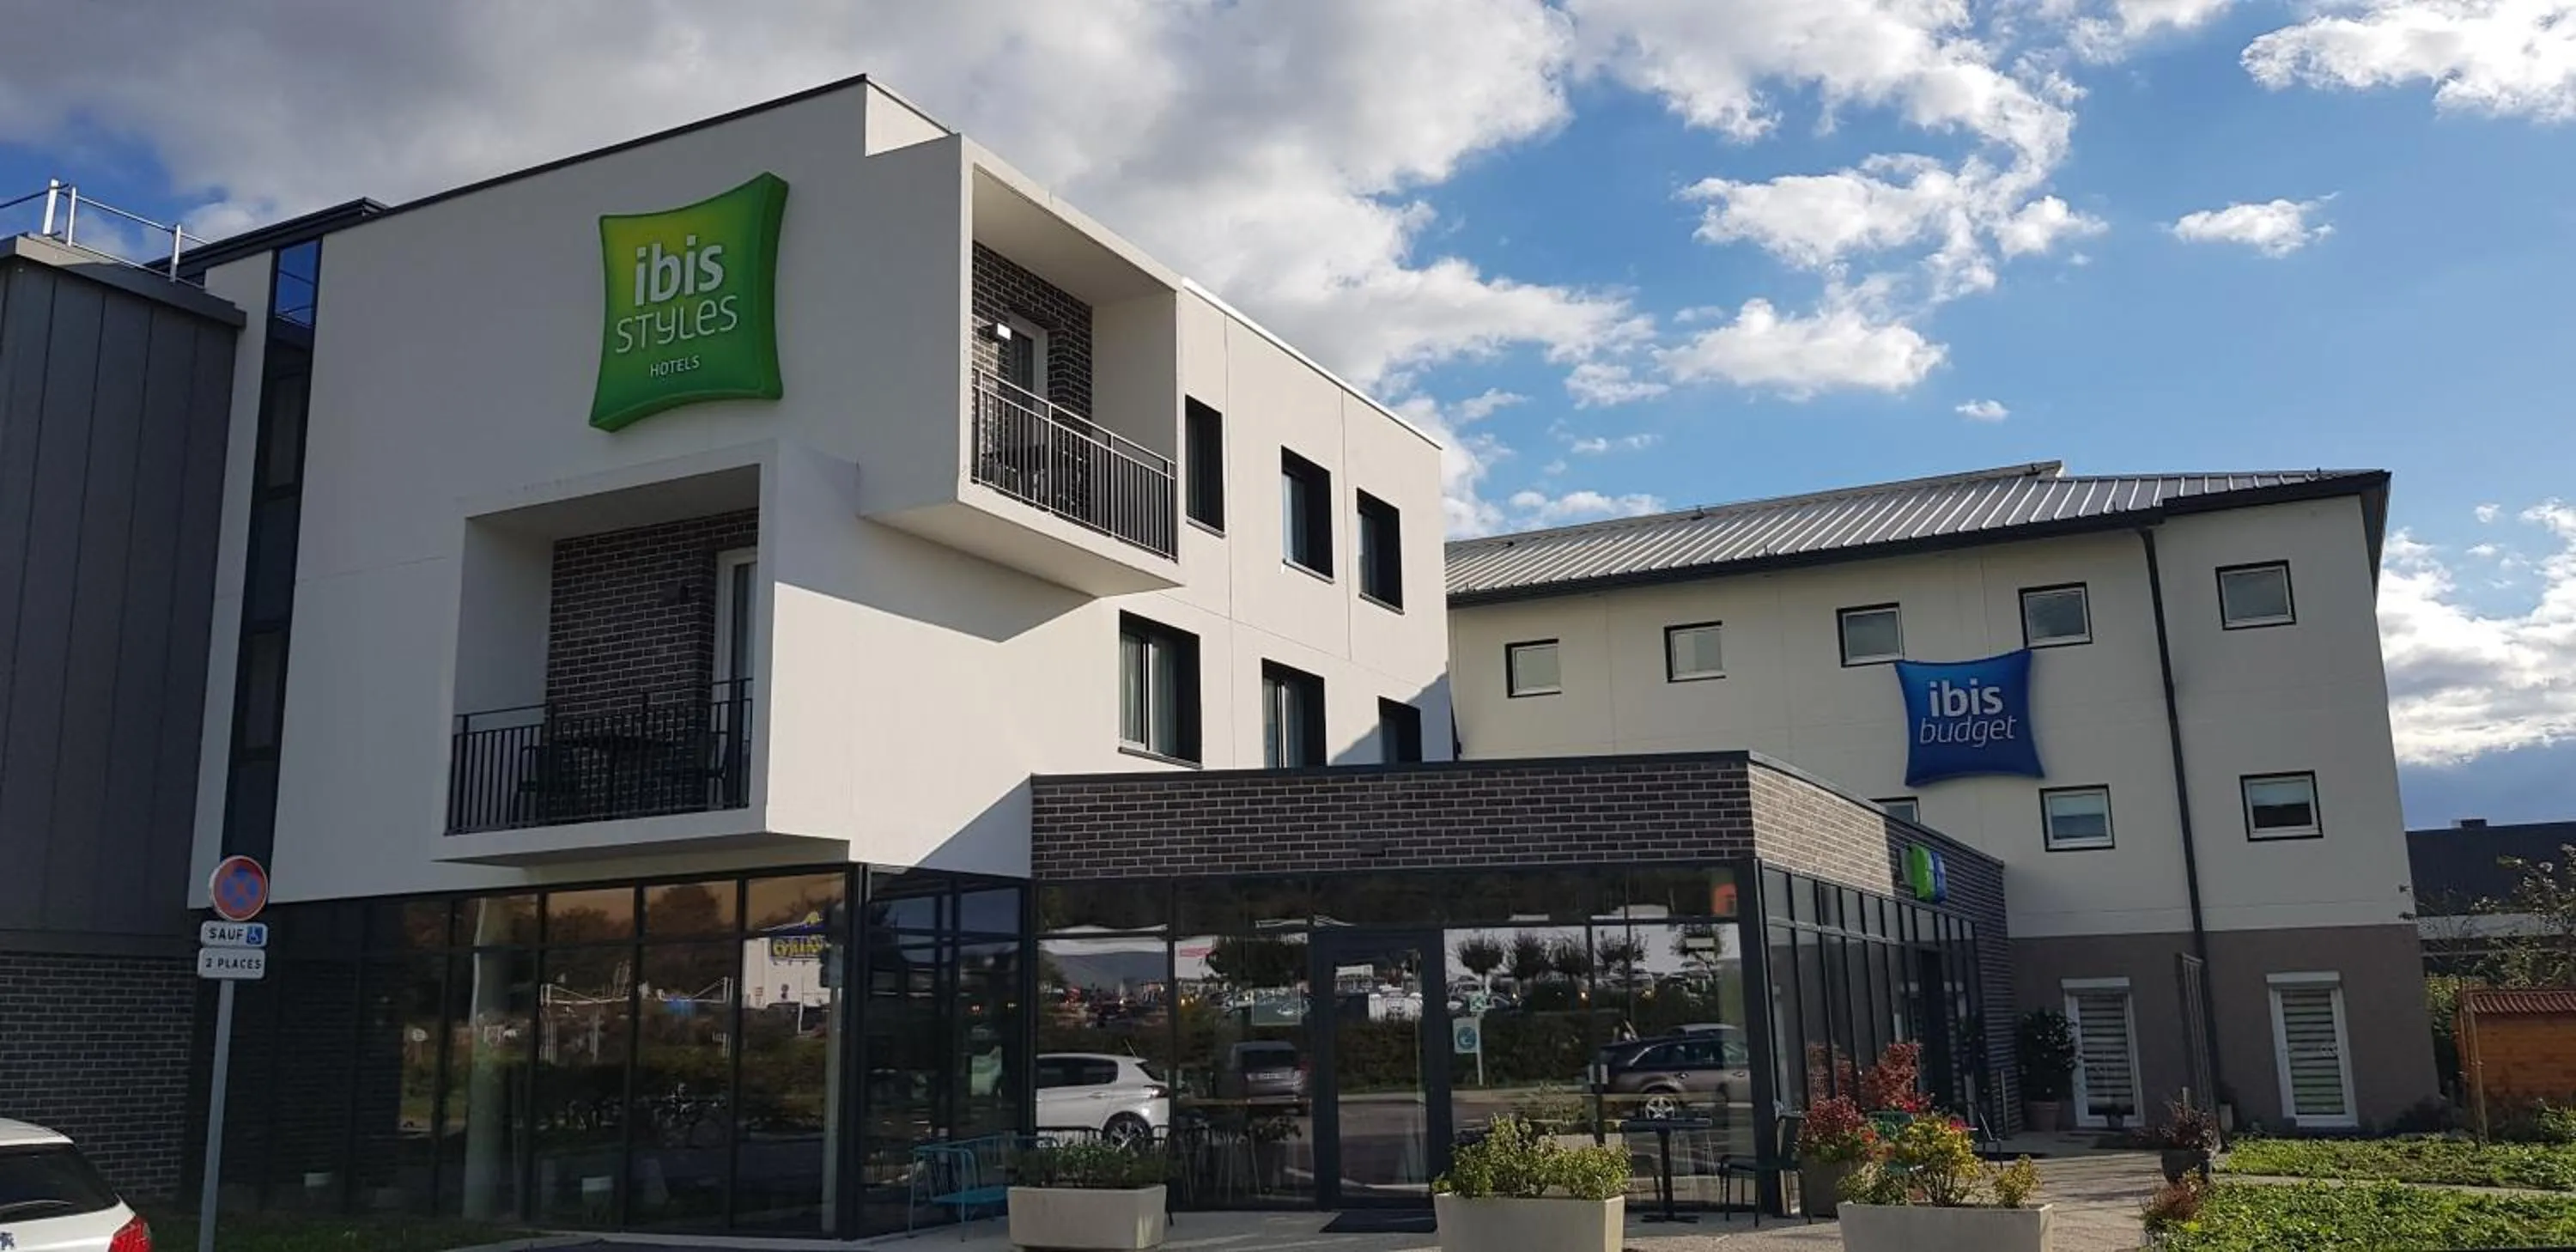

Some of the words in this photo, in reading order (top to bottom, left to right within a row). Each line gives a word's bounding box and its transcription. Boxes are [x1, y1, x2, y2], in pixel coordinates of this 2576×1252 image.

[634, 234, 724, 307] ibis
[650, 355, 701, 378] HOTELS
[1929, 678, 2003, 718] ibis
[1919, 715, 2017, 748] budget
[209, 928, 245, 940] SAUF
[205, 957, 213, 969] 2
[217, 958, 262, 969] PLACES
